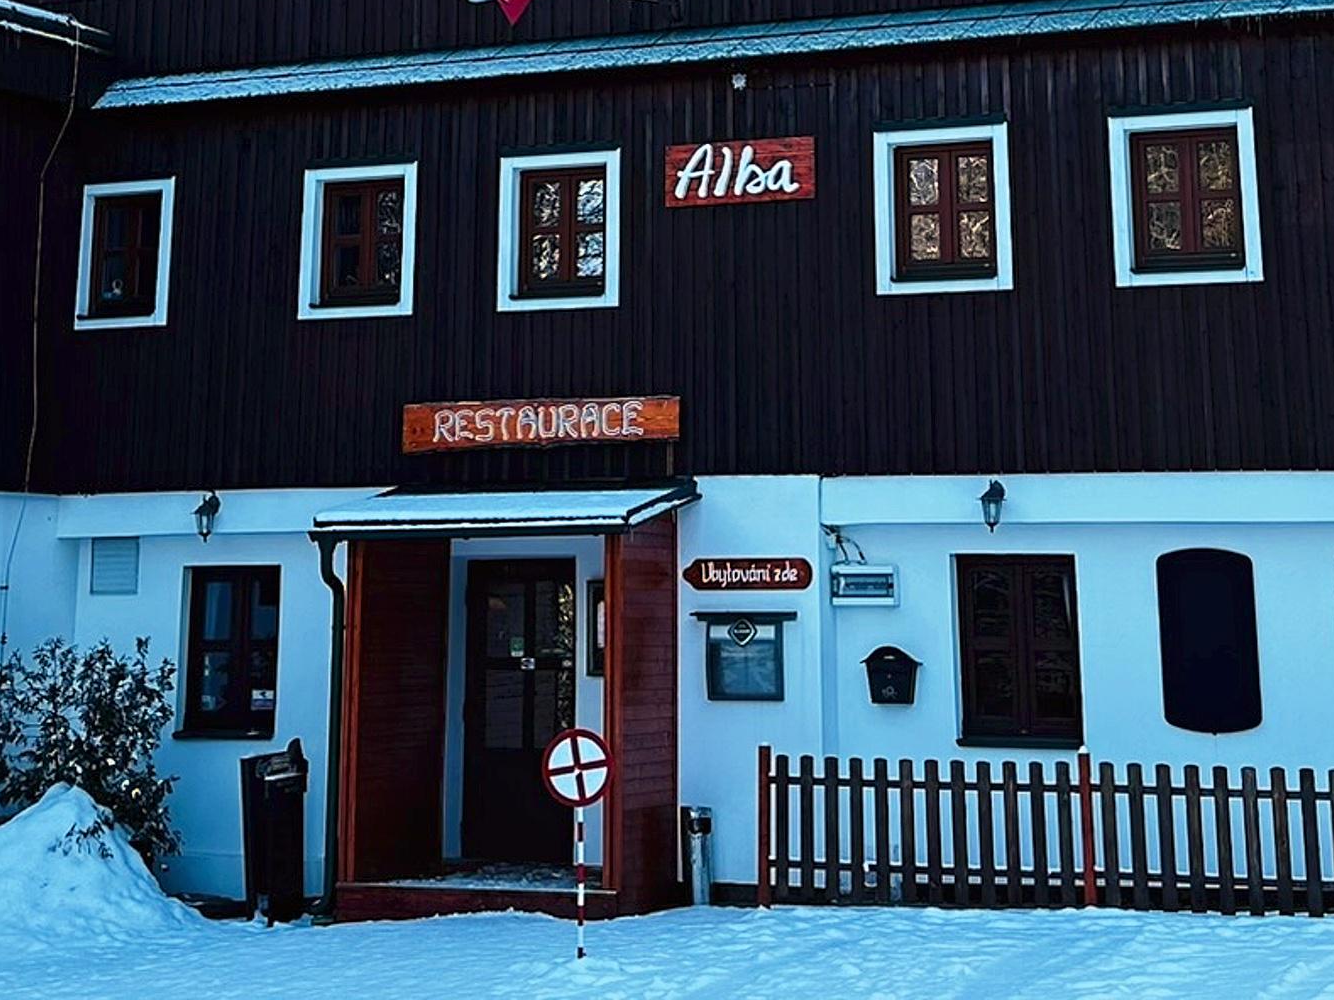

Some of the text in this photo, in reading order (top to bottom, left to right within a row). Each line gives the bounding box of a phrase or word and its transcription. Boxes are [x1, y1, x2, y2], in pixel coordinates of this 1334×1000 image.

[674, 143, 801, 200] Alba
[432, 400, 644, 443] RESTAURACE
[701, 560, 799, 588] Ubytování zde
